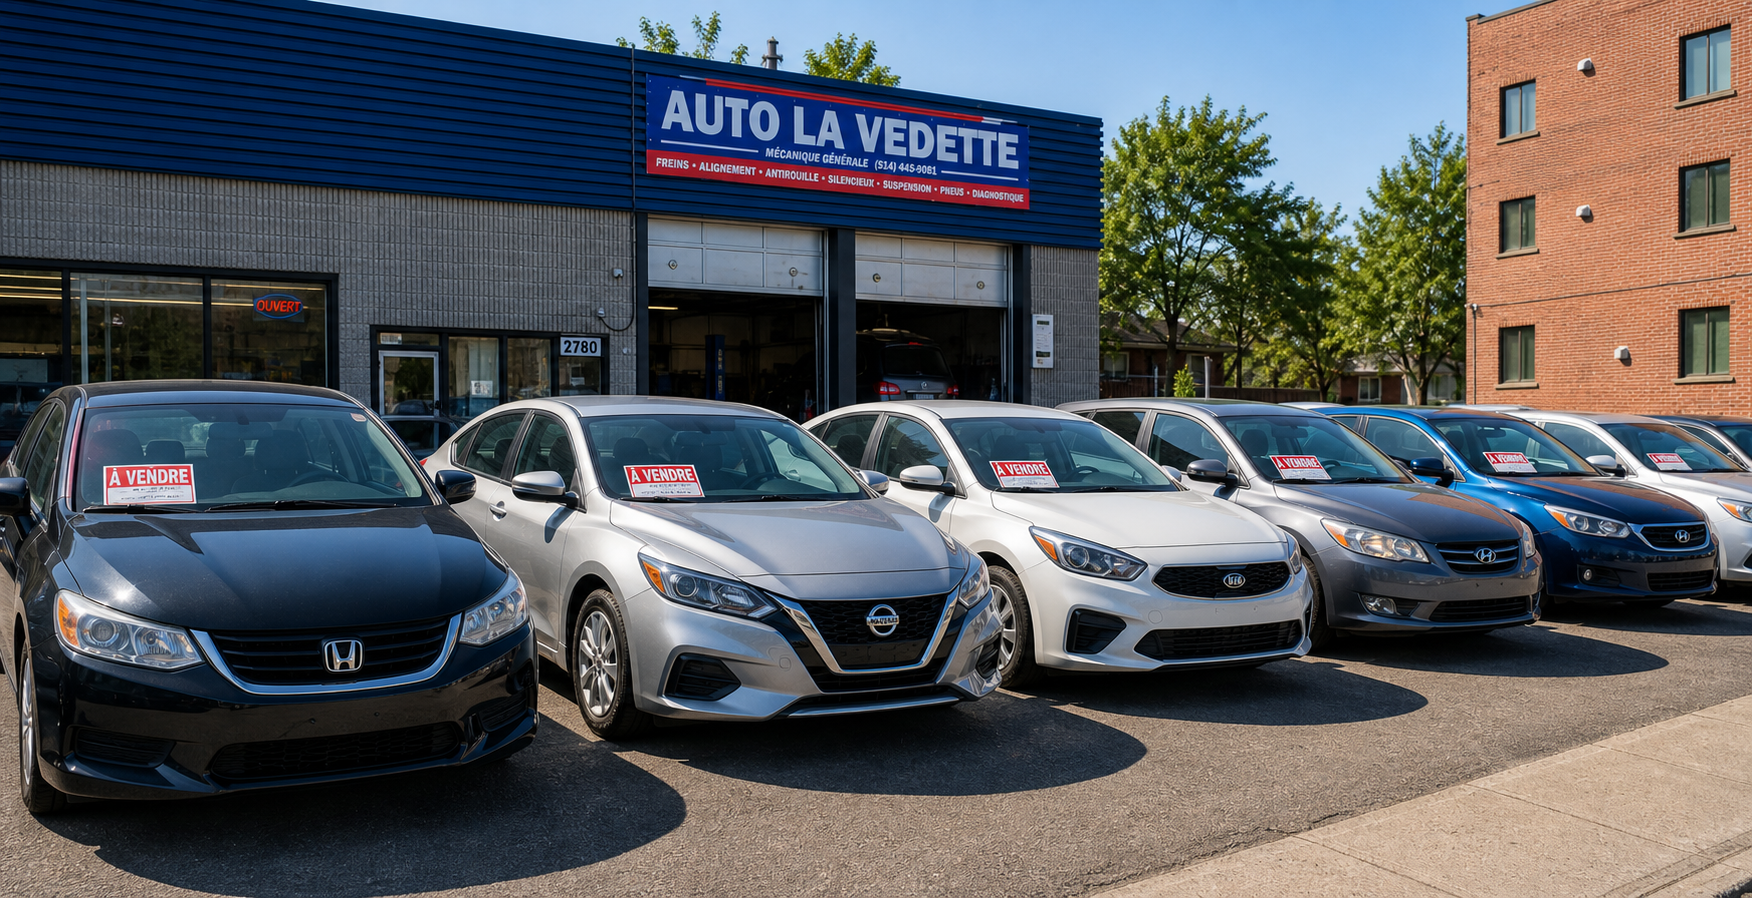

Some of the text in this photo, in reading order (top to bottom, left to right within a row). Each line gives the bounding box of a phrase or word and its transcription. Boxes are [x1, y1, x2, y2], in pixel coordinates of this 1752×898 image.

[661, 89, 1019, 170] AUTO LA VEDETTE
[765, 146, 820, 164] MÉCANIQUE
[822, 152, 869, 168] GÉNÉRALE
[656, 157, 689, 170] FREINS
[699, 162, 756, 176] ALIGNEMENT
[765, 168, 819, 182] ANTIROUILLE
[828, 174, 875, 188] SILENCIEUX
[883, 180, 932, 193] SUSPENSION
[972, 189, 1024, 203] DIAGNOSTIQUE
[256, 299, 301, 313] OUVERT
[564, 340, 597, 353] 2780
[109, 467, 189, 486] À VENDRE
[630, 467, 695, 483] À VENDRE
[1004, 463, 1049, 475] VENDRE
